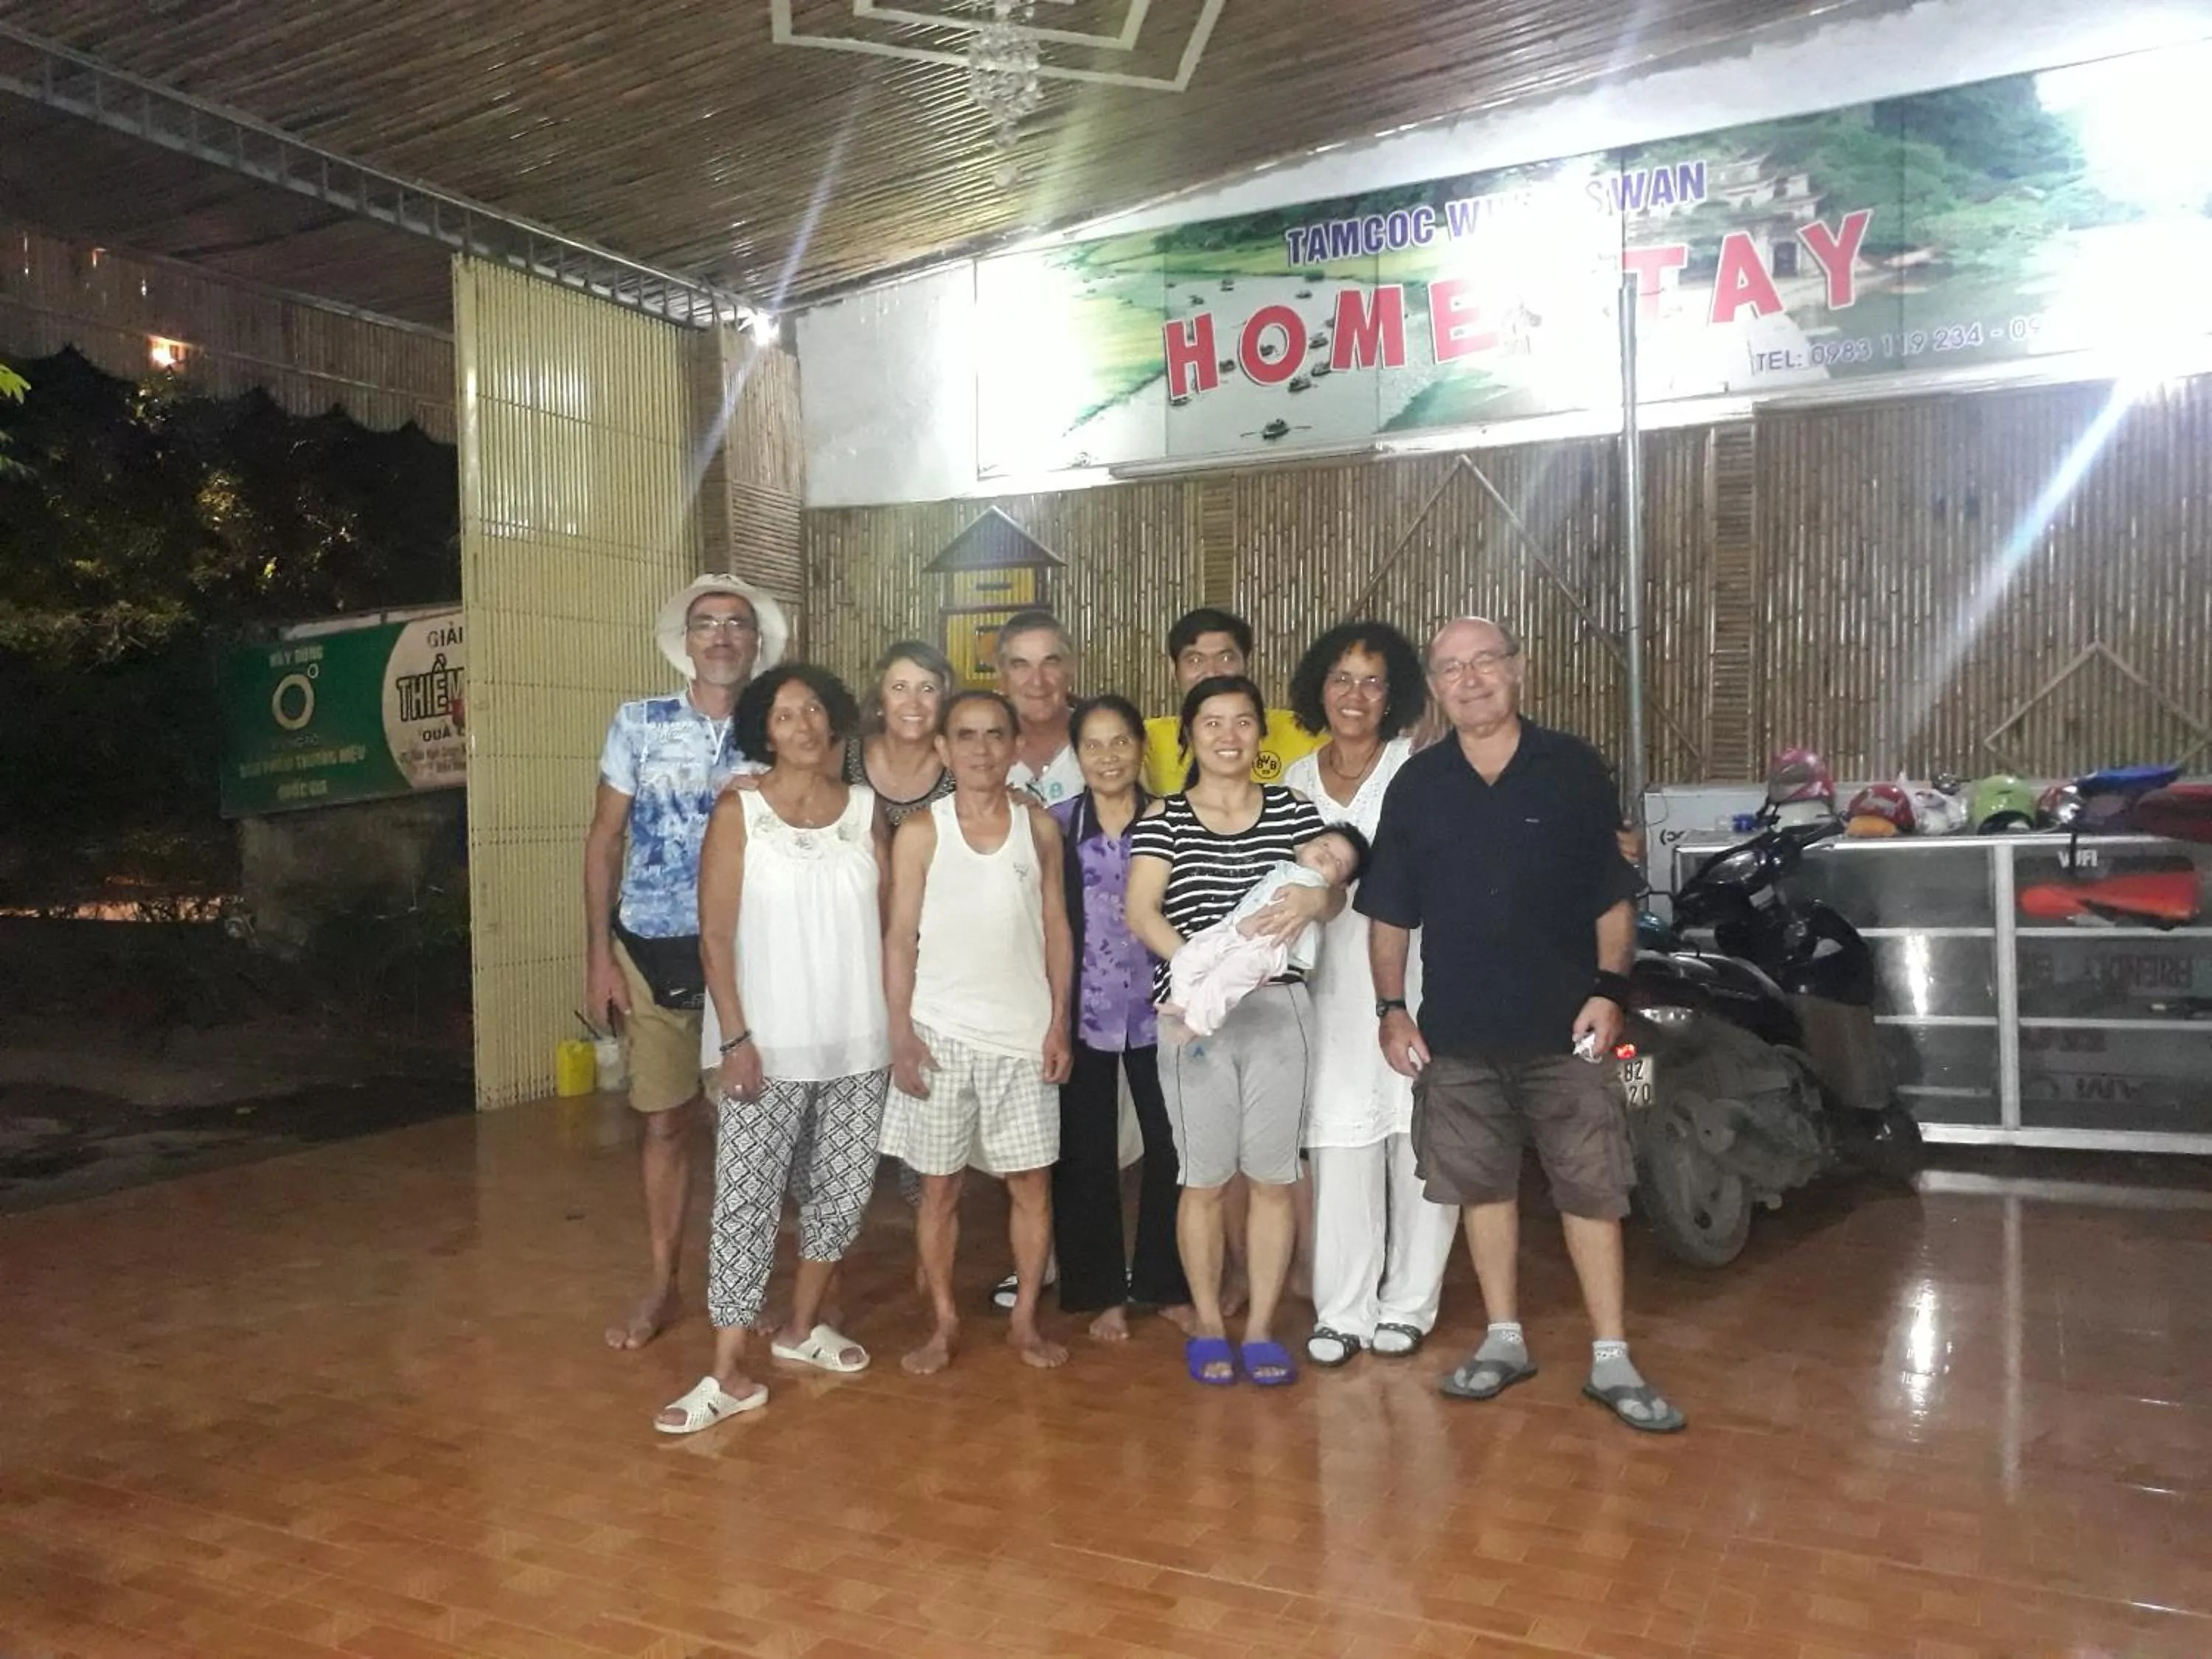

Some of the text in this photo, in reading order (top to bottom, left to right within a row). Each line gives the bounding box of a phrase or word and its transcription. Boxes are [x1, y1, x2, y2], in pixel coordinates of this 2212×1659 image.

[1285, 205, 1435, 266] TAMCOC
[1756, 350, 1802, 372] TEL:
[1933, 320, 1983, 352] 234
